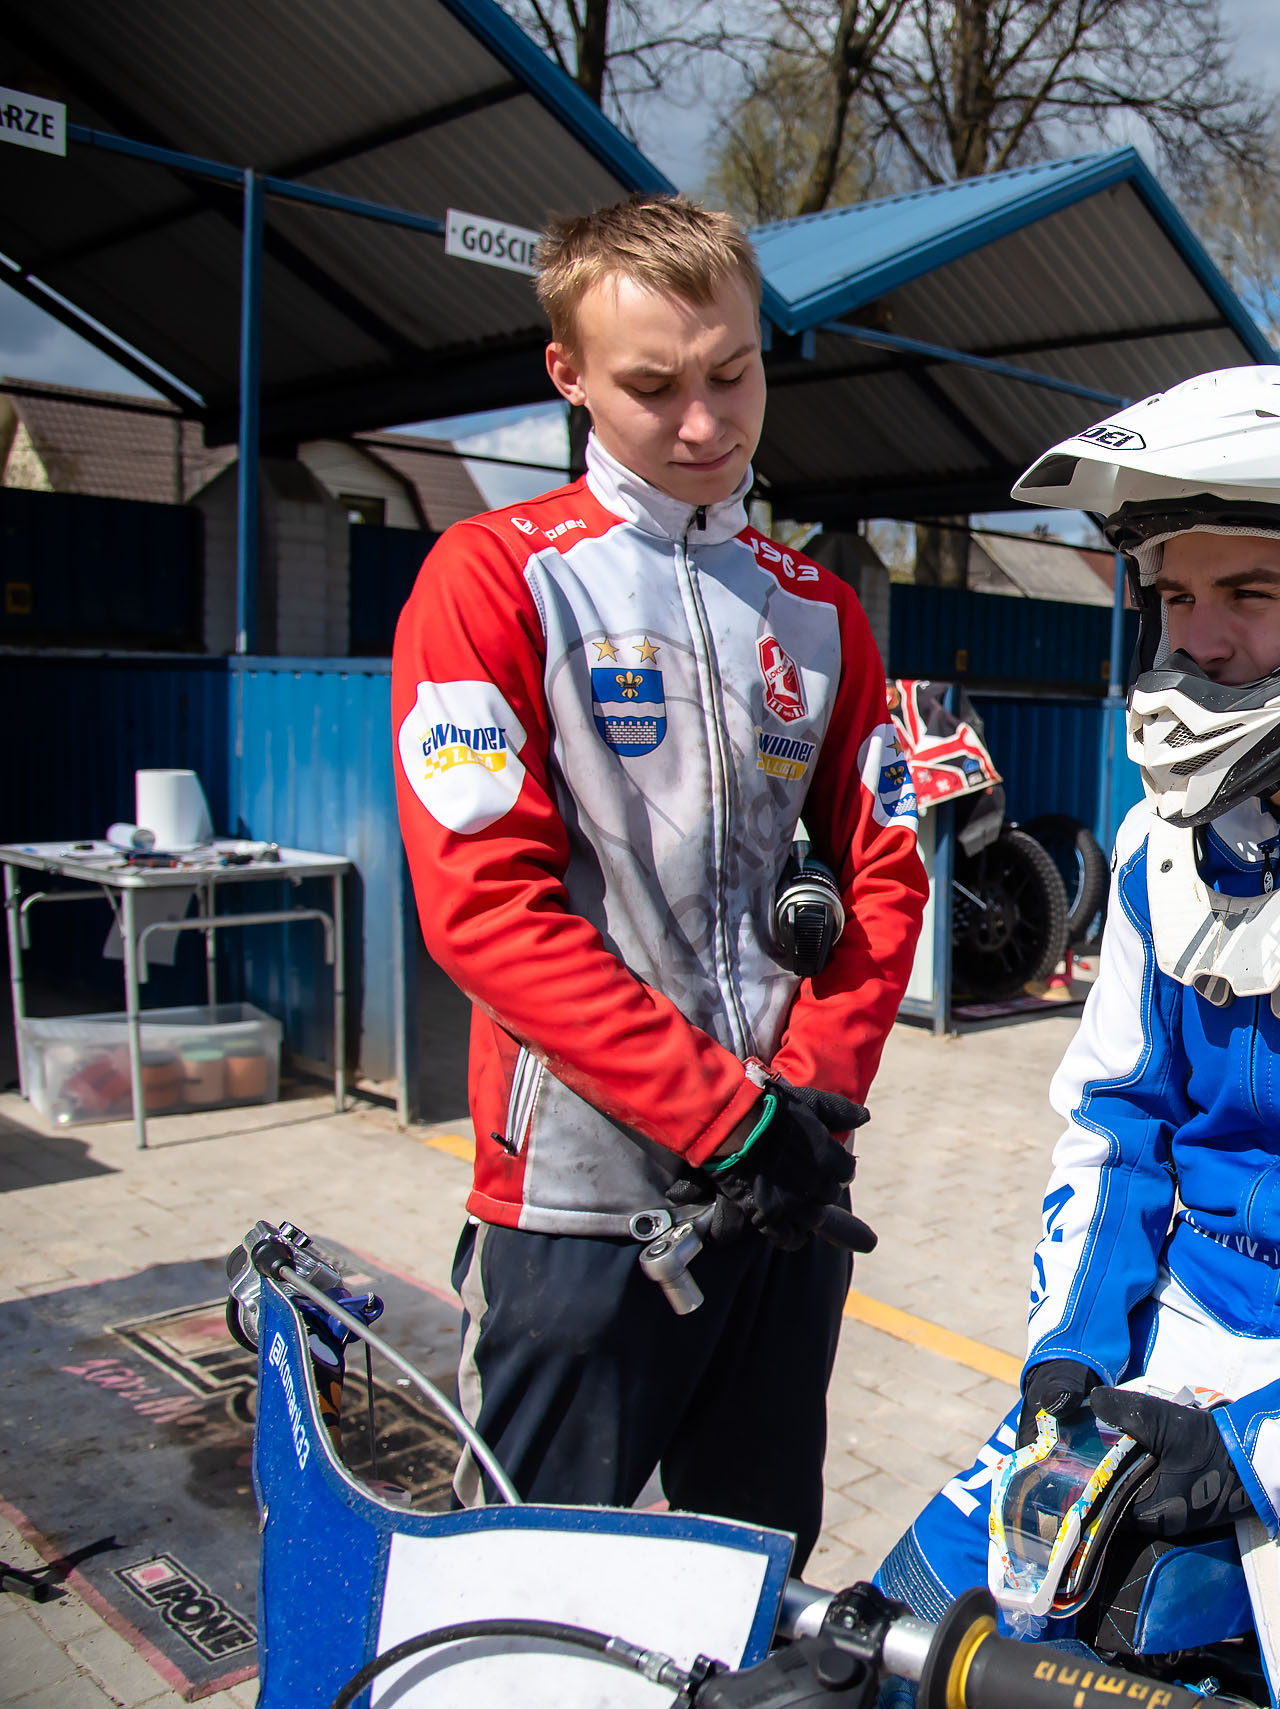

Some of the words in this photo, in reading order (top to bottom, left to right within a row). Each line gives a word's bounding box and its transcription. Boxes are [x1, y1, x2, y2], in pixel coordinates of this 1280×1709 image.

[0, 104, 55, 140] RZE
[1077, 427, 1135, 447] OEI
[541, 518, 588, 541] peed
[750, 537, 820, 581] 1963
[758, 732, 815, 763] Winner
[144, 1576, 254, 1655] IPONE
[1033, 1660, 1174, 1709] domino
